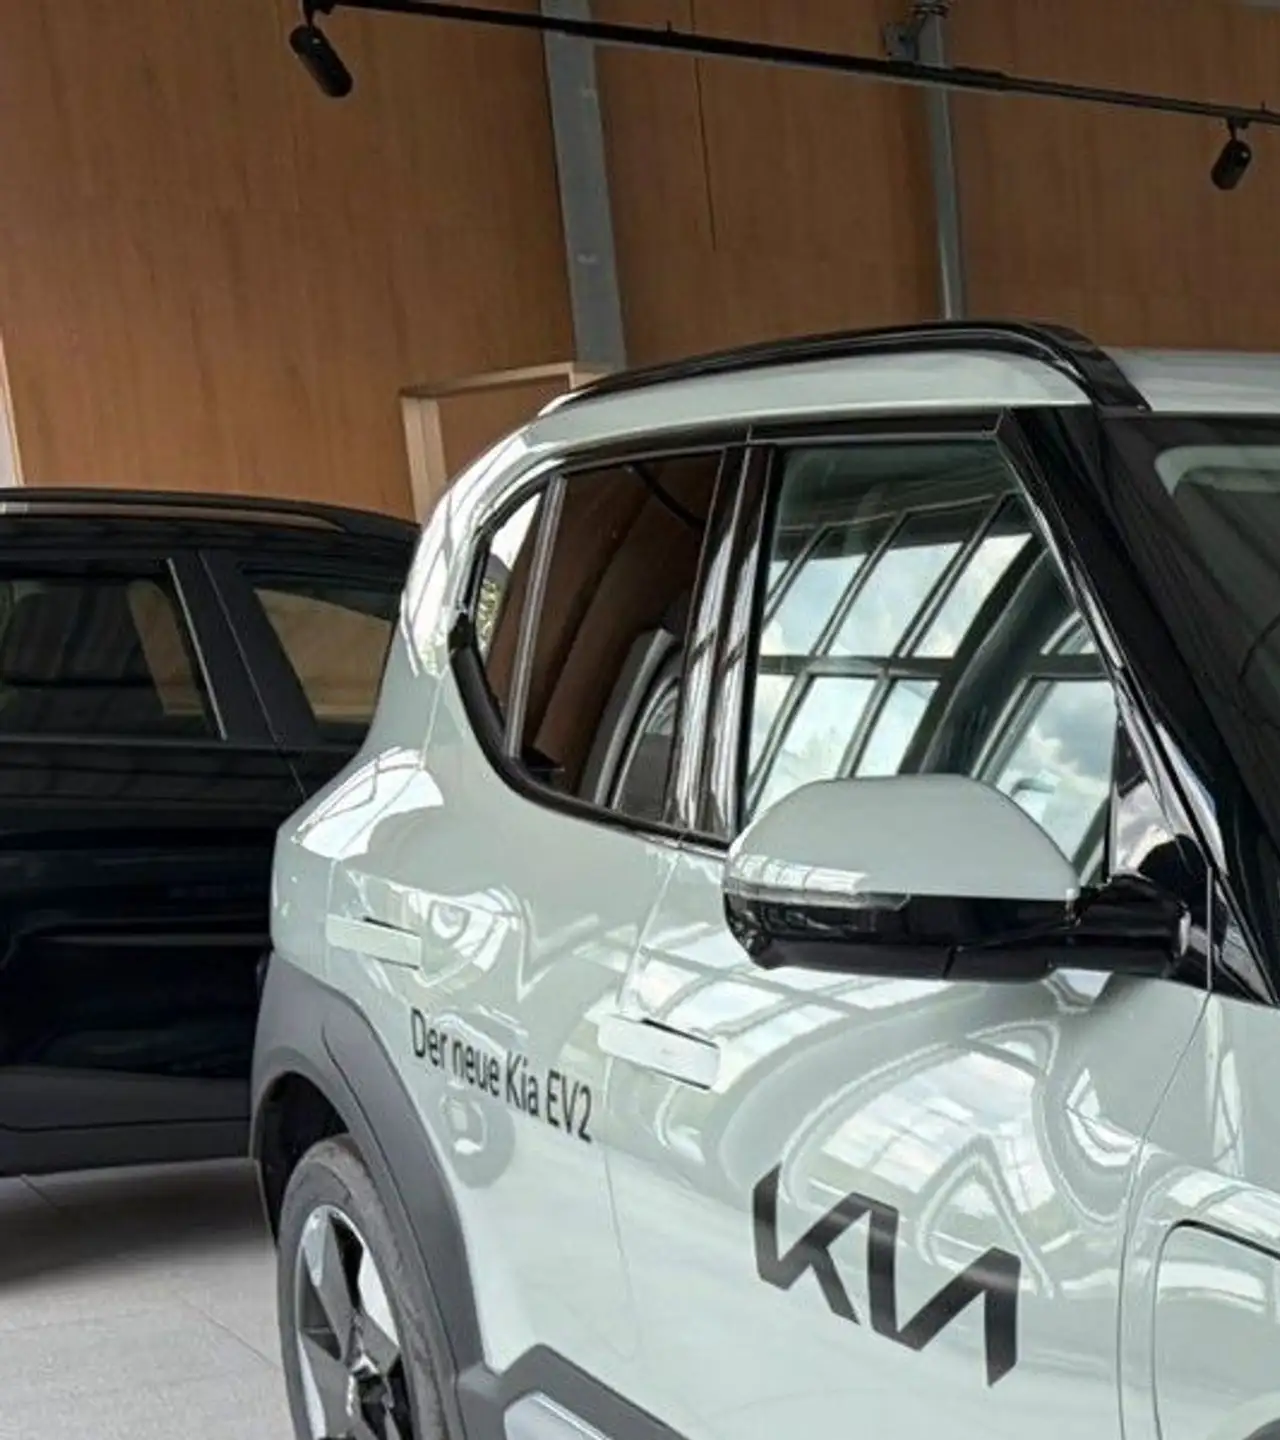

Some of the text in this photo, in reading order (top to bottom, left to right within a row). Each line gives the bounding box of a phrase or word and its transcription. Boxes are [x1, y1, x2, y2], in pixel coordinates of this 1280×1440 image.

[410, 1007, 593, 1144] Der neue Kia EV2
[753, 1160, 1021, 1388] KIA
